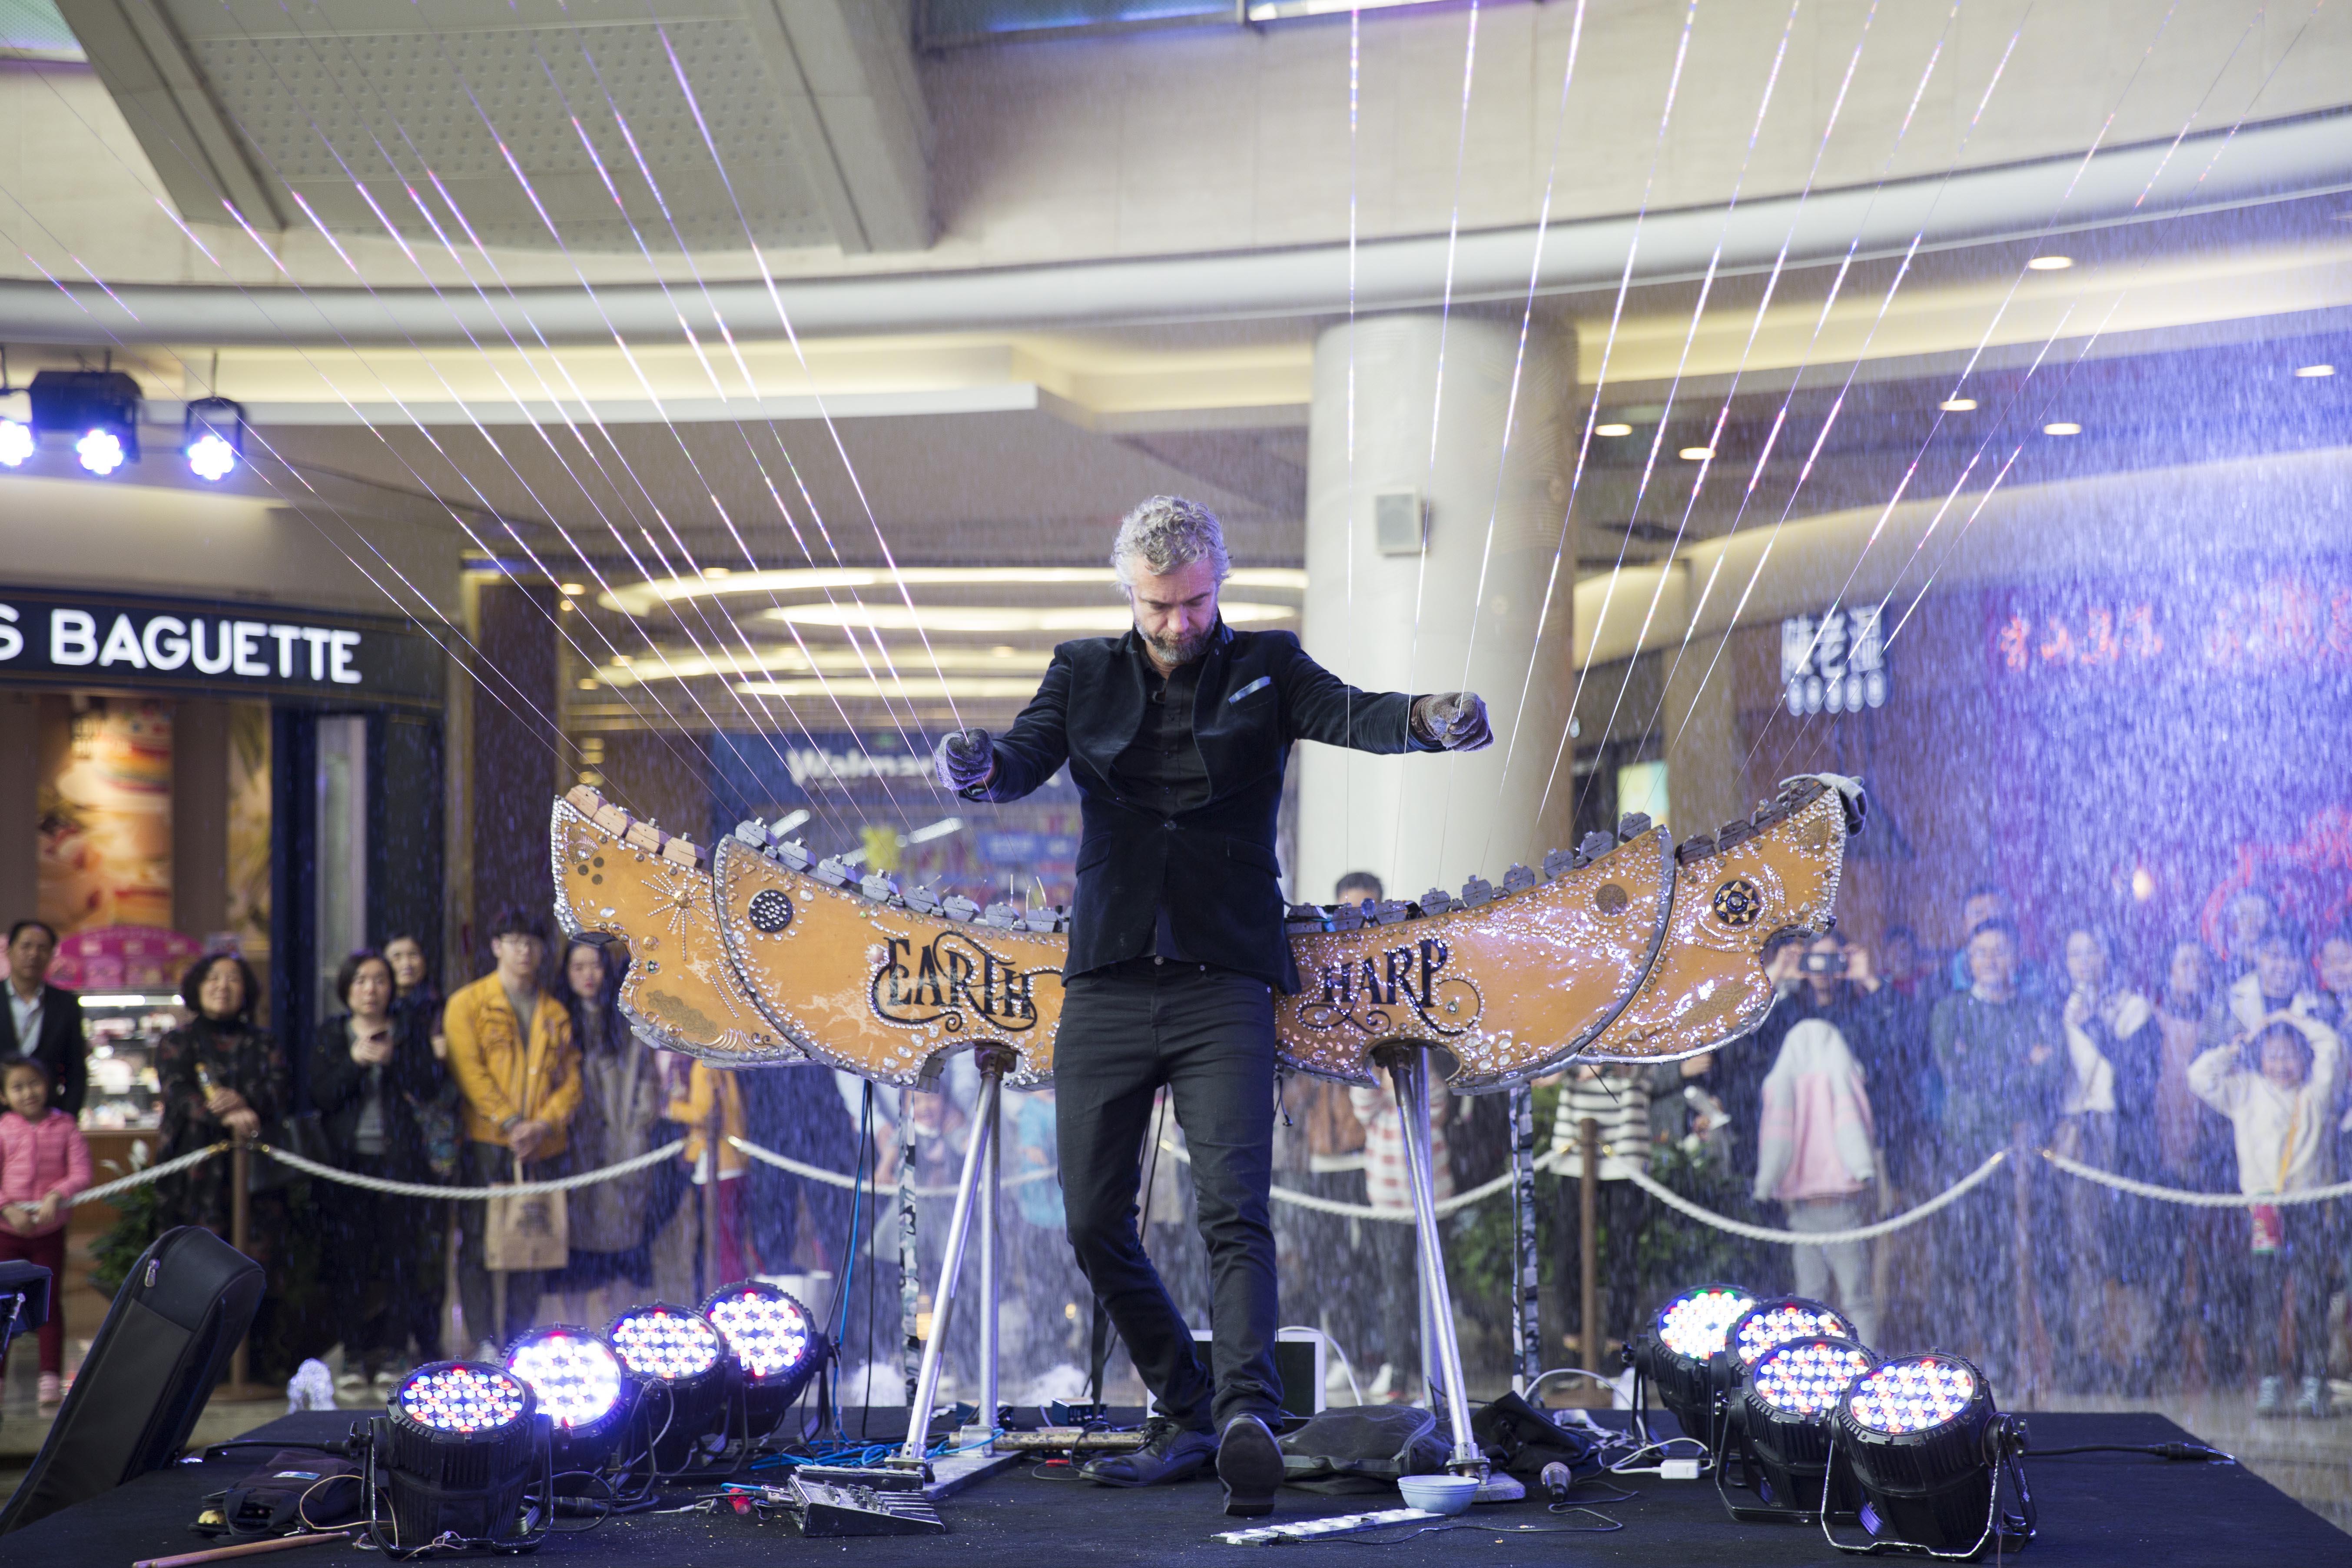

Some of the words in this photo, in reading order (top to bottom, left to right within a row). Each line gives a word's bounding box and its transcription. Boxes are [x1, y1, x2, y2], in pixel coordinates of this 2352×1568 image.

[50, 608, 362, 684] BAGUETTE
[785, 747, 936, 786] Walmar
[872, 931, 1041, 1032] EARTH
[1301, 938, 1466, 1033] HARP
